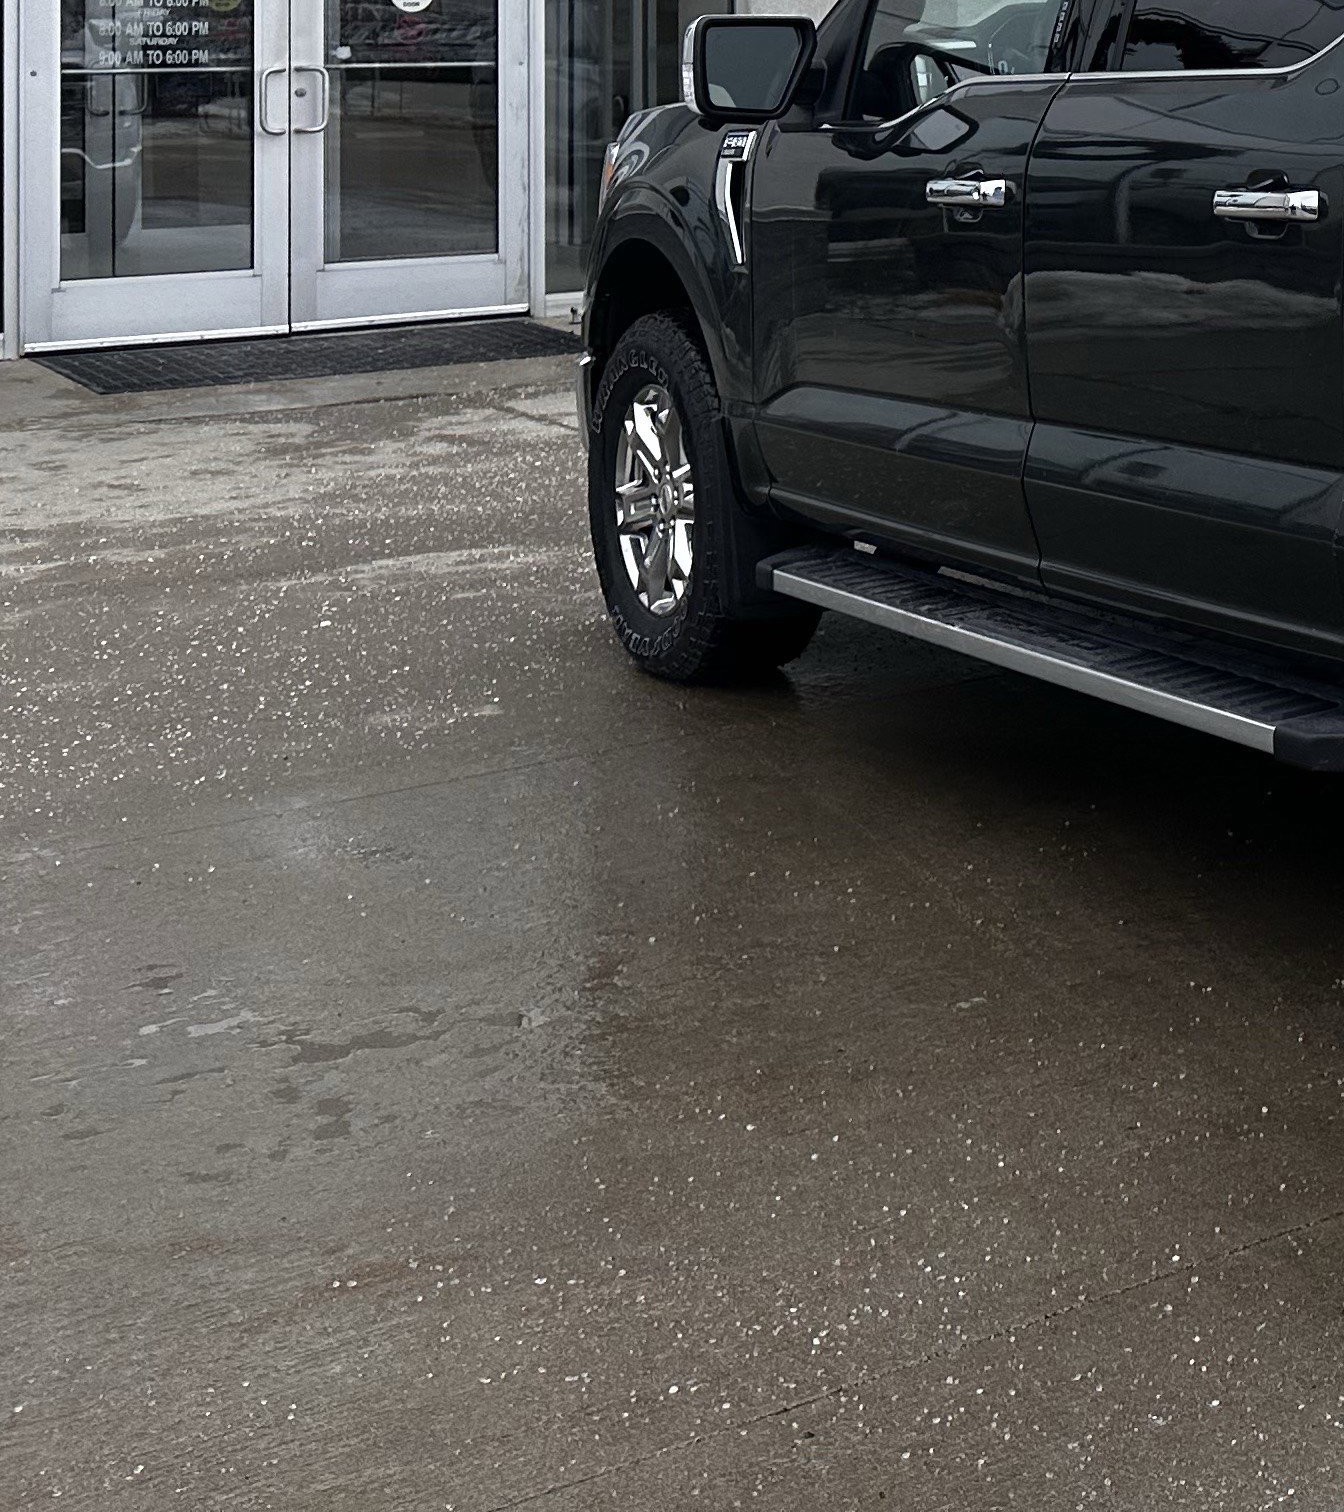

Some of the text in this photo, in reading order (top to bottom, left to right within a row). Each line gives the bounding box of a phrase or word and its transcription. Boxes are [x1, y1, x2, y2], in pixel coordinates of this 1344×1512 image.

[126, 22, 144, 35] AM
[148, 22, 163, 35] TO
[165, 22, 189, 35] 6:00
[192, 22, 209, 35] PM
[129, 37, 179, 46] SATURDAY
[125, 50, 144, 64] AM
[147, 50, 163, 64] TO
[165, 50, 189, 64] 6:00
[192, 50, 209, 64] PM
